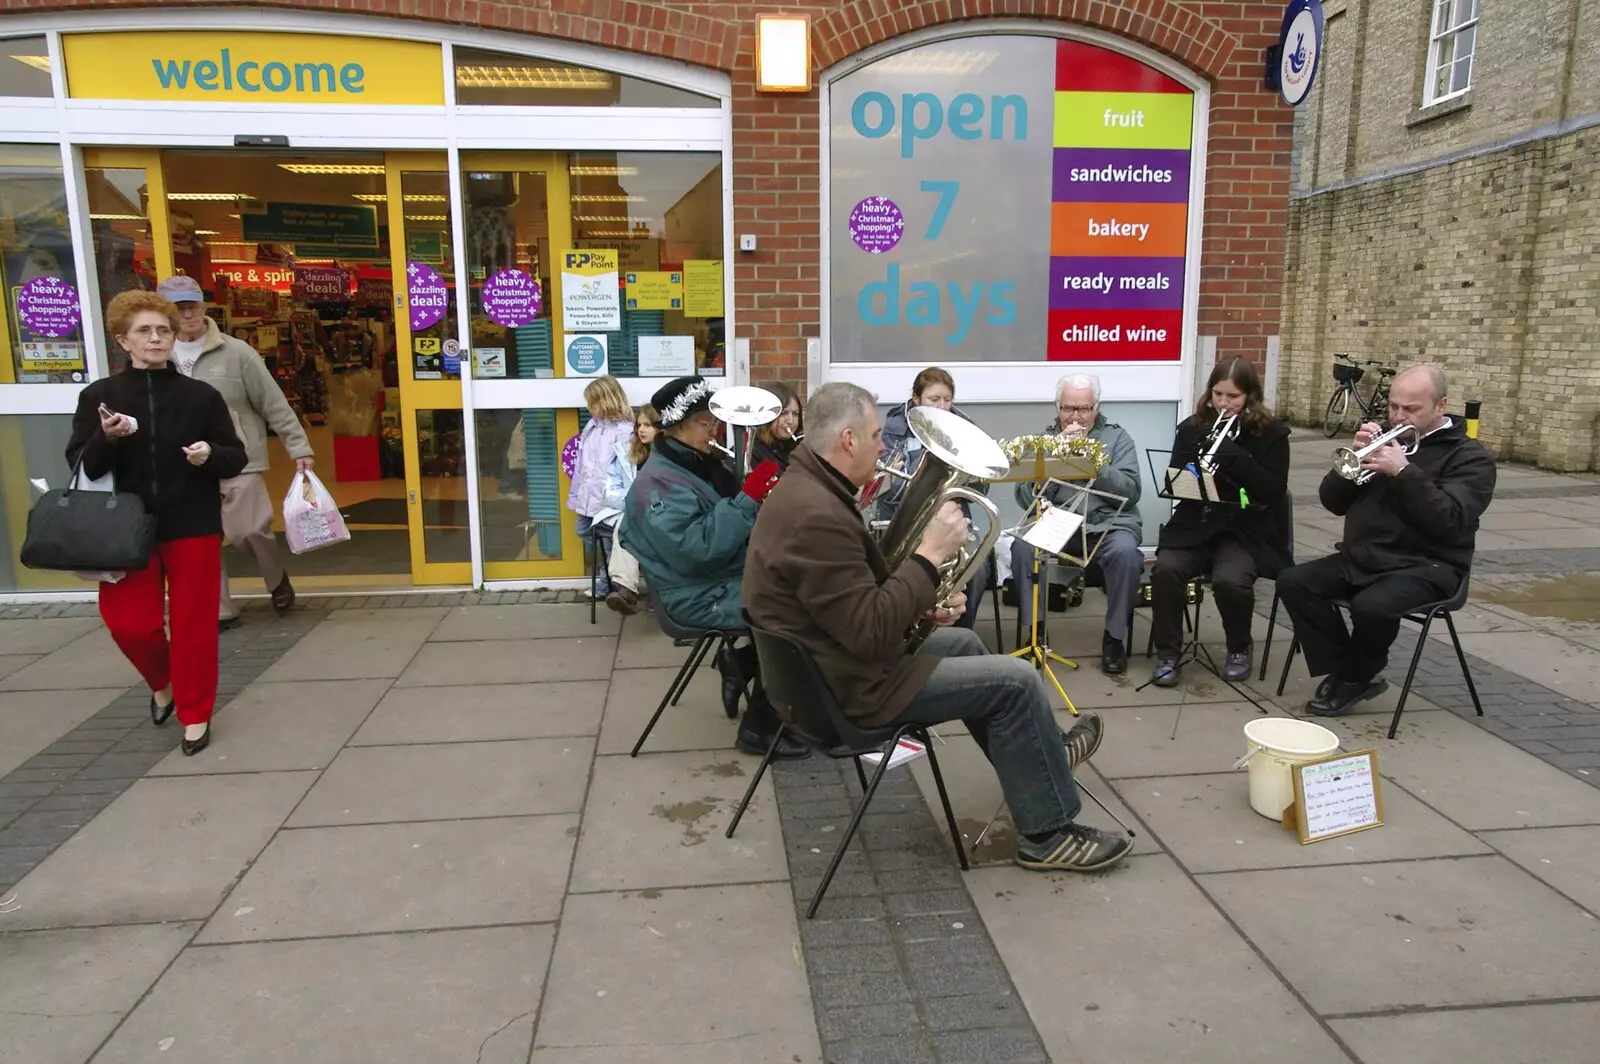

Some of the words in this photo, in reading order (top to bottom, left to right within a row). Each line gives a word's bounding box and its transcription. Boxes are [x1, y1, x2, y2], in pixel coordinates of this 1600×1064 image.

[152, 48, 365, 93] welcome
[1103, 109, 1144, 128] fruit
[850, 91, 1028, 159] open
[1070, 164, 1172, 183] sandwiches
[862, 203, 890, 215] heavy
[920, 181, 960, 241] 7
[858, 215, 895, 223] Christmas
[857, 223, 895, 233] shopping?
[1088, 219, 1150, 241] bakery
[621, 241, 641, 252] help
[591, 253, 606, 262] Pay
[248, 269, 260, 282] &
[305, 272, 342, 284] dazzling
[306, 282, 342, 294] deals!
[496, 276, 526, 288] heavy
[1063, 272, 1114, 295] ready
[1120, 272, 1170, 290] meals
[32, 284, 64, 296] heavy
[410, 286, 446, 296] dazzling
[492, 288, 531, 297] Christmas
[28, 296, 70, 305] Christmas
[410, 295, 447, 306] deals!
[492, 297, 531, 306] shopping?
[857, 263, 1017, 345] days
[28, 304, 72, 315] shopping?
[1062, 325, 1120, 342] chilled
[1126, 326, 1167, 342] wine
